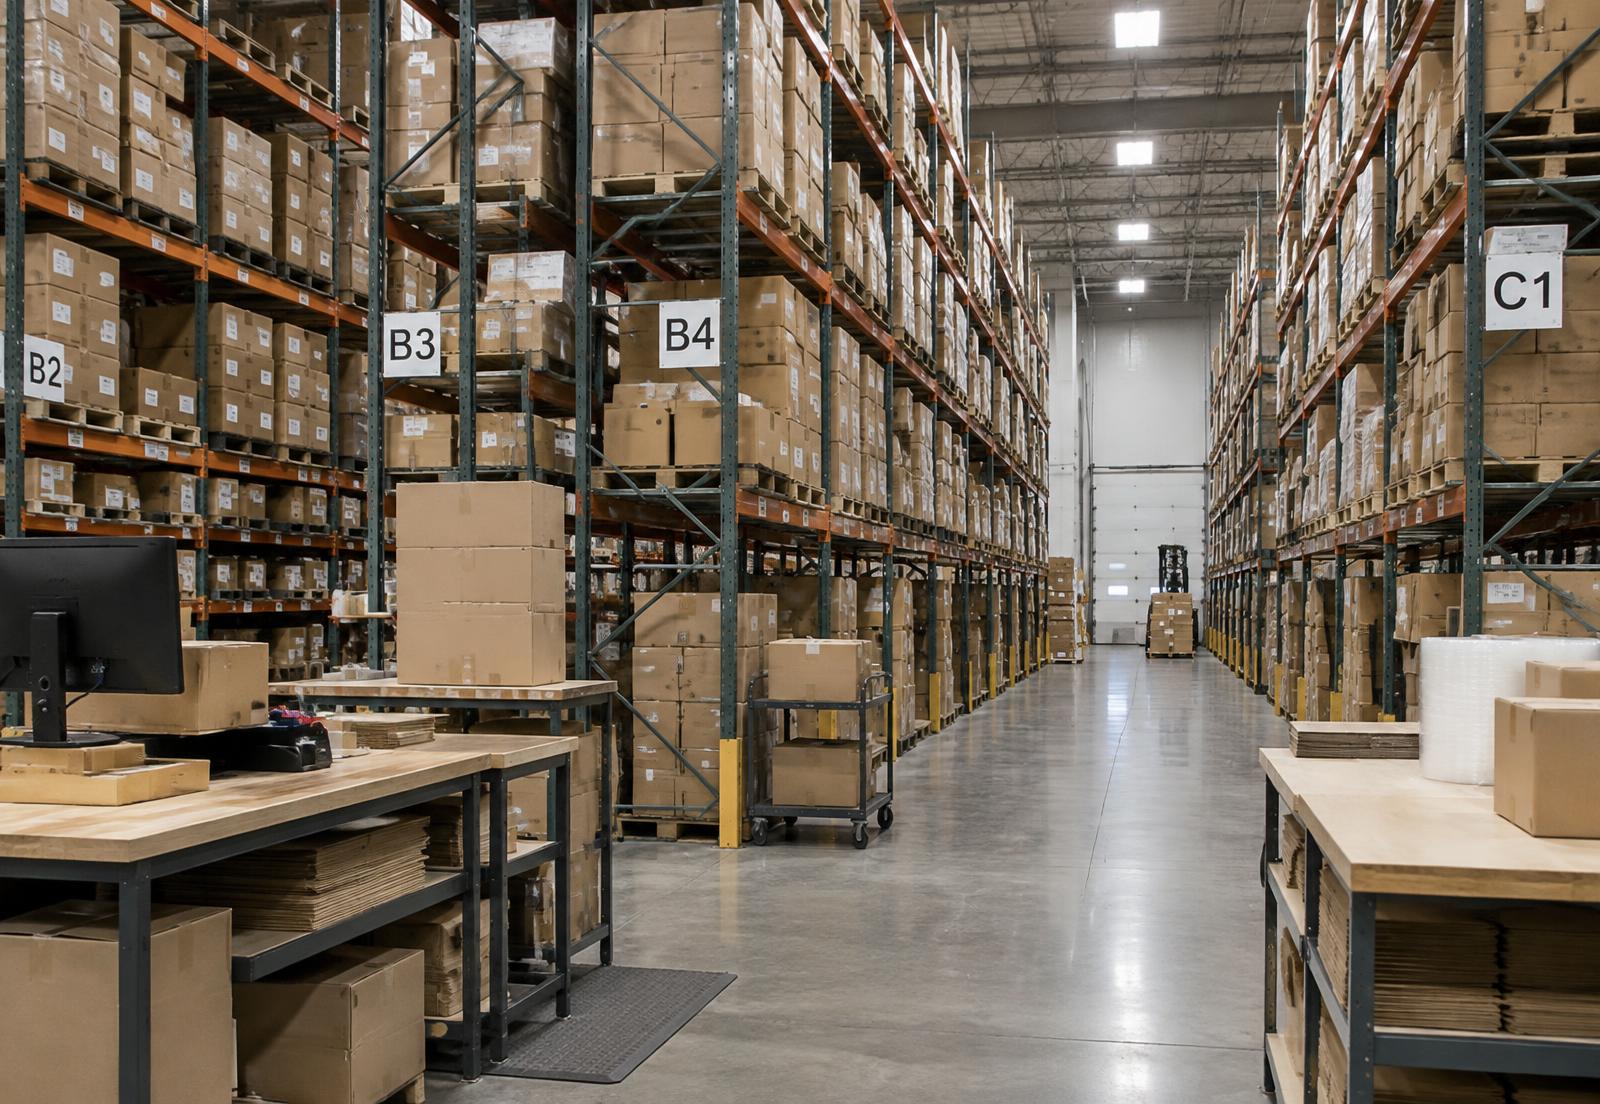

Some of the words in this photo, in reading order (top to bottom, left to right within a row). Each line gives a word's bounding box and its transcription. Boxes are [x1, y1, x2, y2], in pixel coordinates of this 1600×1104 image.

[1494, 271, 1550, 311] C1
[390, 327, 436, 361] B3
[666, 316, 715, 352] B4
[30, 351, 62, 388] B2
